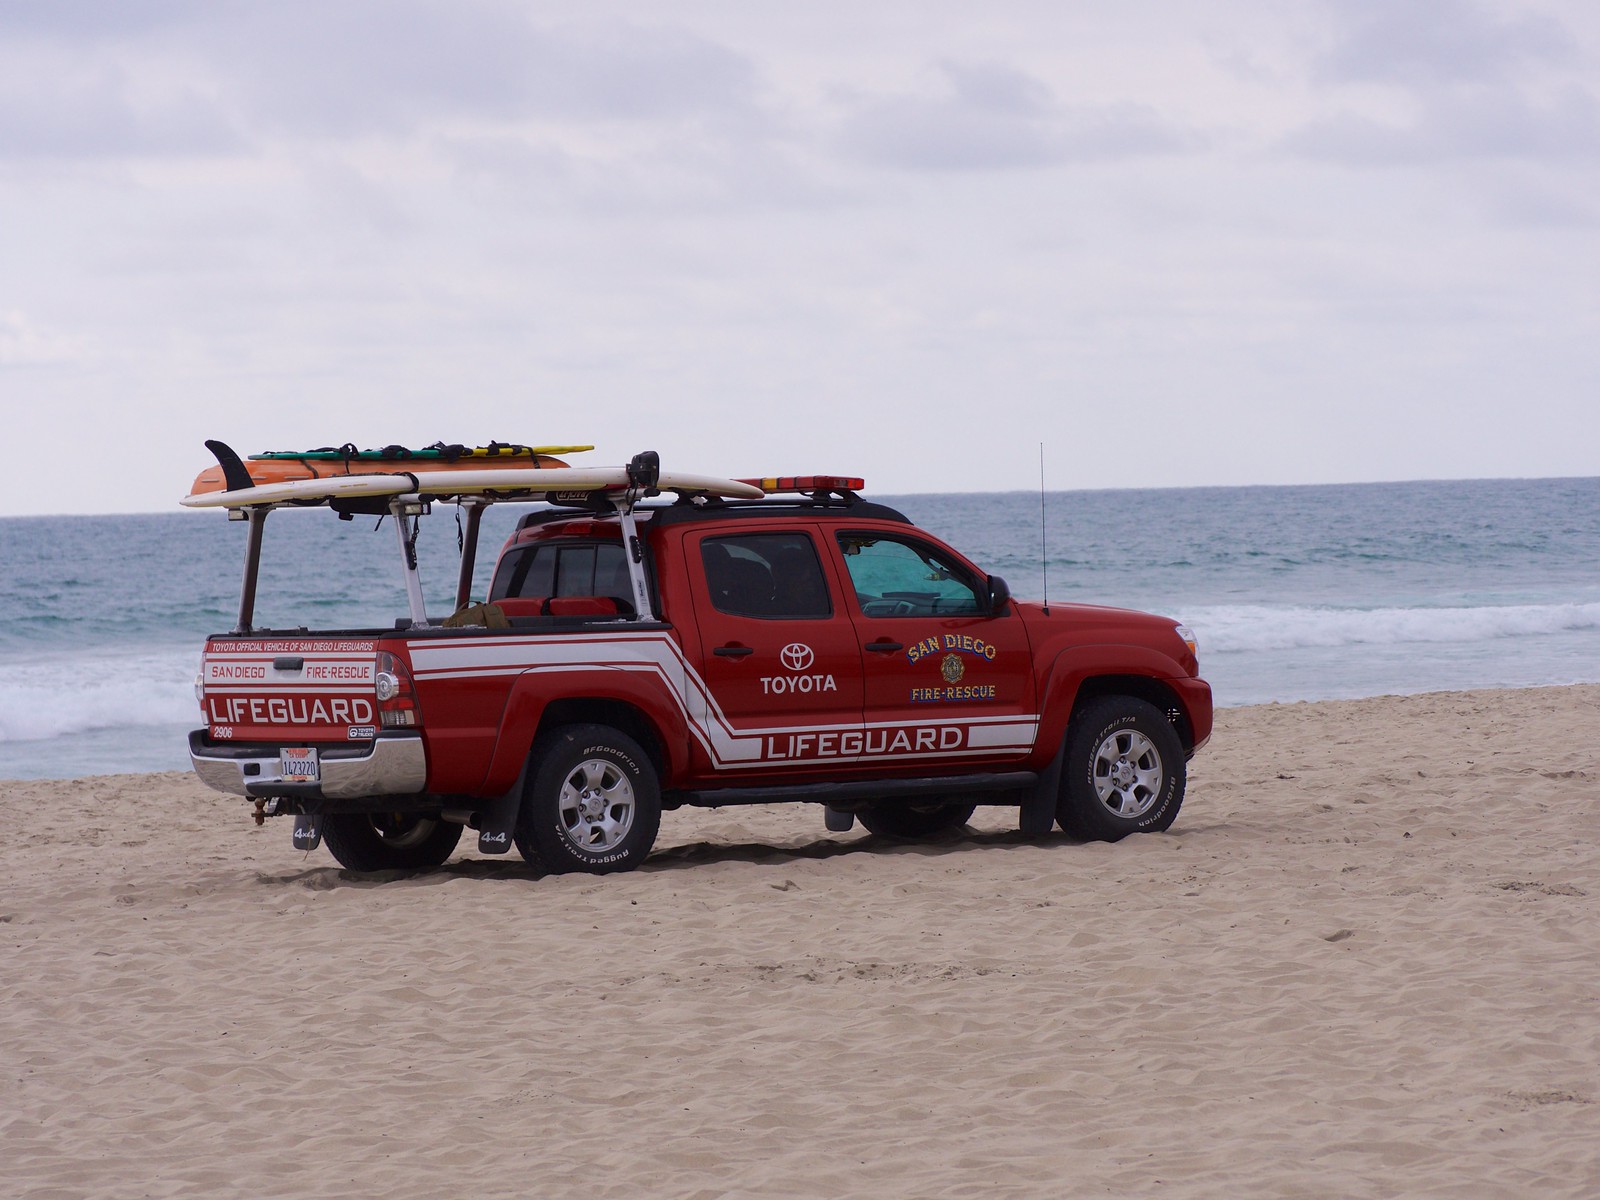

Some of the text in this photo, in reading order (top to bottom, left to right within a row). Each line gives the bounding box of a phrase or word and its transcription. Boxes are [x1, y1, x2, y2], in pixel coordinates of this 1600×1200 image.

[213, 643, 373, 652] TOYOTA OFFICIAL VEHICLE OF SAN DIEGO LIFEGUARDS
[906, 634, 996, 665] SAN DIEGO
[212, 666, 233, 678] SAN
[235, 666, 265, 678] DIEGO
[760, 674, 837, 694] TOYOTA
[910, 685, 996, 703] FIRE-RESCUE
[210, 699, 373, 723] LIFEGUARD
[214, 726, 233, 738] 2906
[767, 727, 963, 759] LIFEGUARD
[284, 761, 316, 776] 1423220
[294, 828, 316, 839] 4x4
[481, 832, 506, 842] 4x4
[590, 849, 629, 864] Rugged
